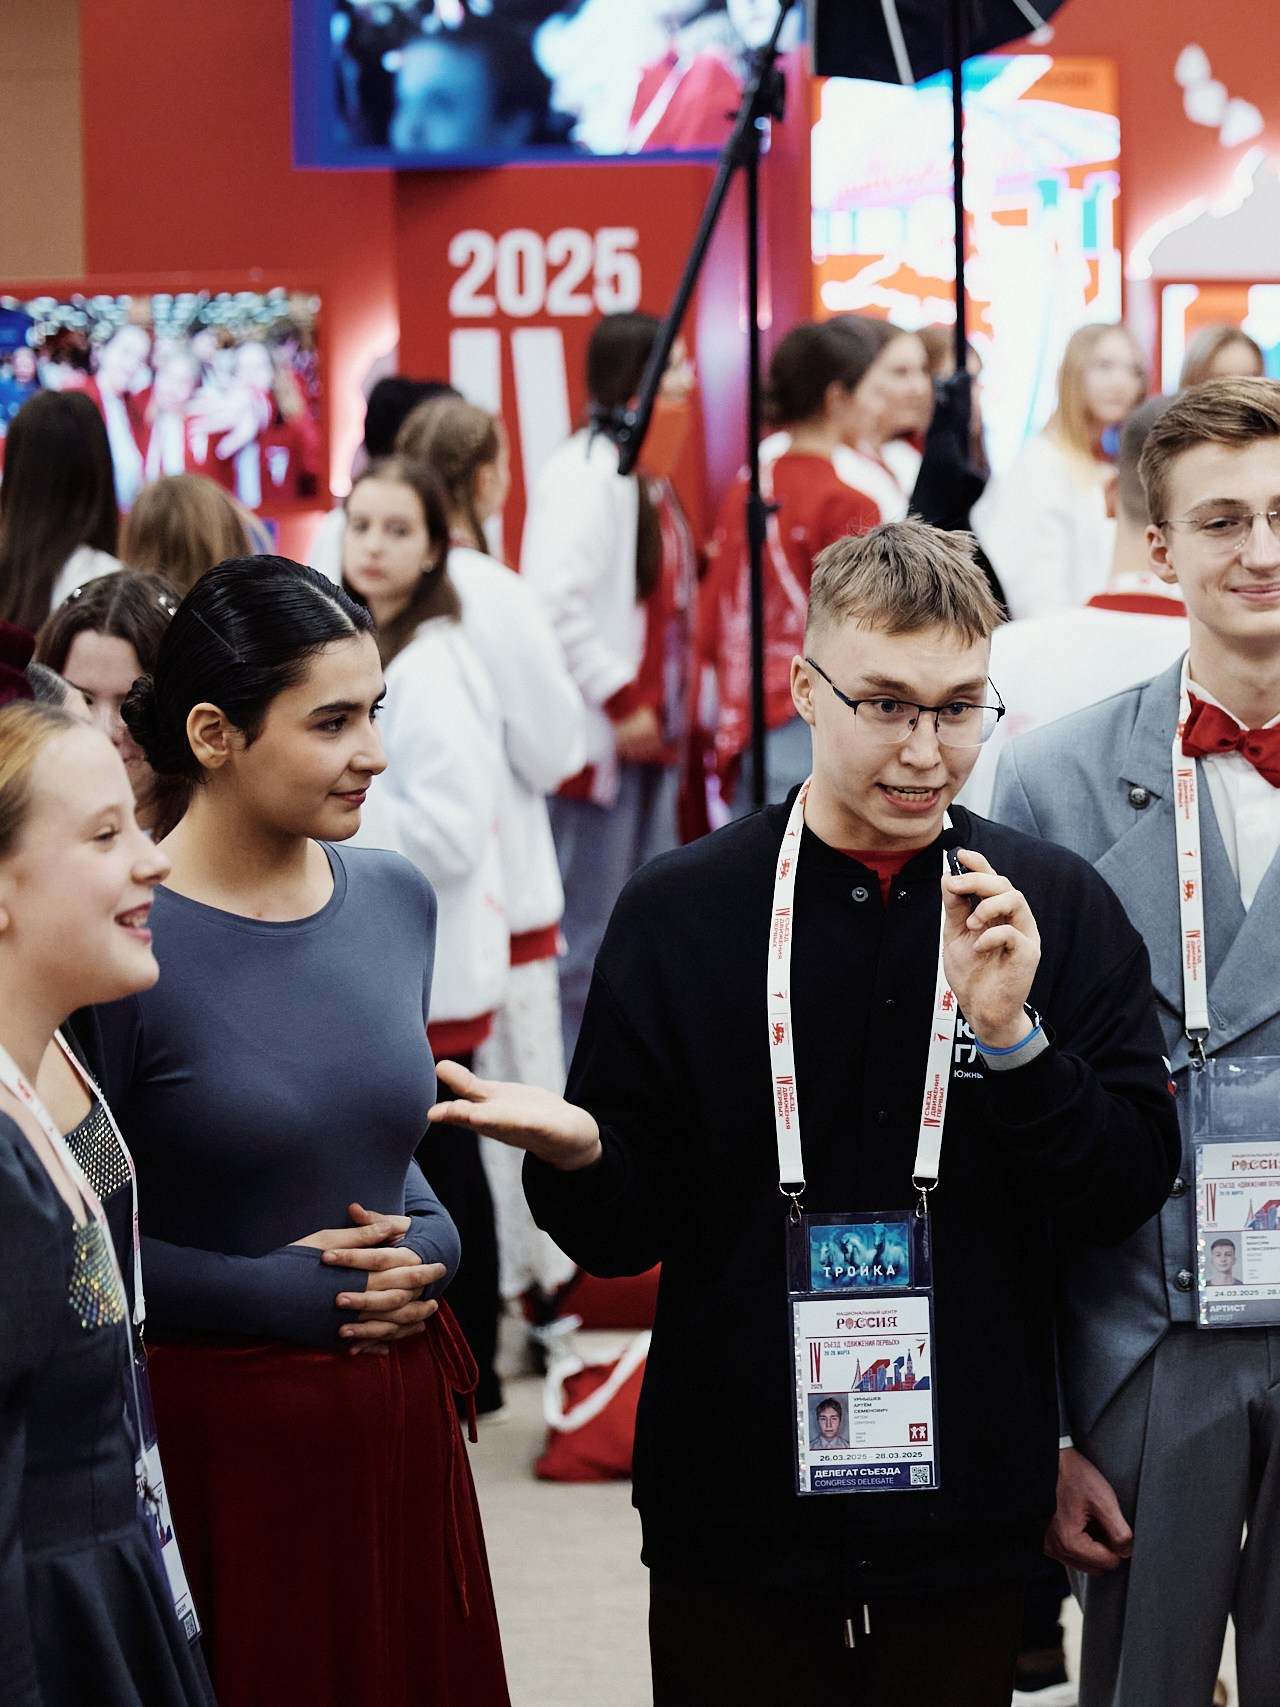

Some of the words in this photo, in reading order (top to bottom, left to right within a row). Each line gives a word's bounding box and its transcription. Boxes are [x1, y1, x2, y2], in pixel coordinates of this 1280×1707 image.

[449, 227, 642, 318] 2025
[775, 907, 790, 916] IV
[776, 1076, 793, 1084] IV
[931, 1074, 940, 1116] ДВИЖЕНИЯ
[782, 1087, 790, 1130] ДВИЖЕНИЯ
[923, 1117, 941, 1128] IV
[823, 1262, 896, 1278] ТРОЙКА
[1210, 1304, 1246, 1312] АРТИСТ
[836, 1316, 898, 1330] РОССИЯ
[809, 1342, 821, 1383] IV
[814, 1468, 859, 1478] ДЕЛЕГАТ
[860, 1467, 901, 1476] СЪЕЗДА
[815, 1478, 856, 1487] CONGRESS
[858, 1477, 894, 1485] DELEGATE
